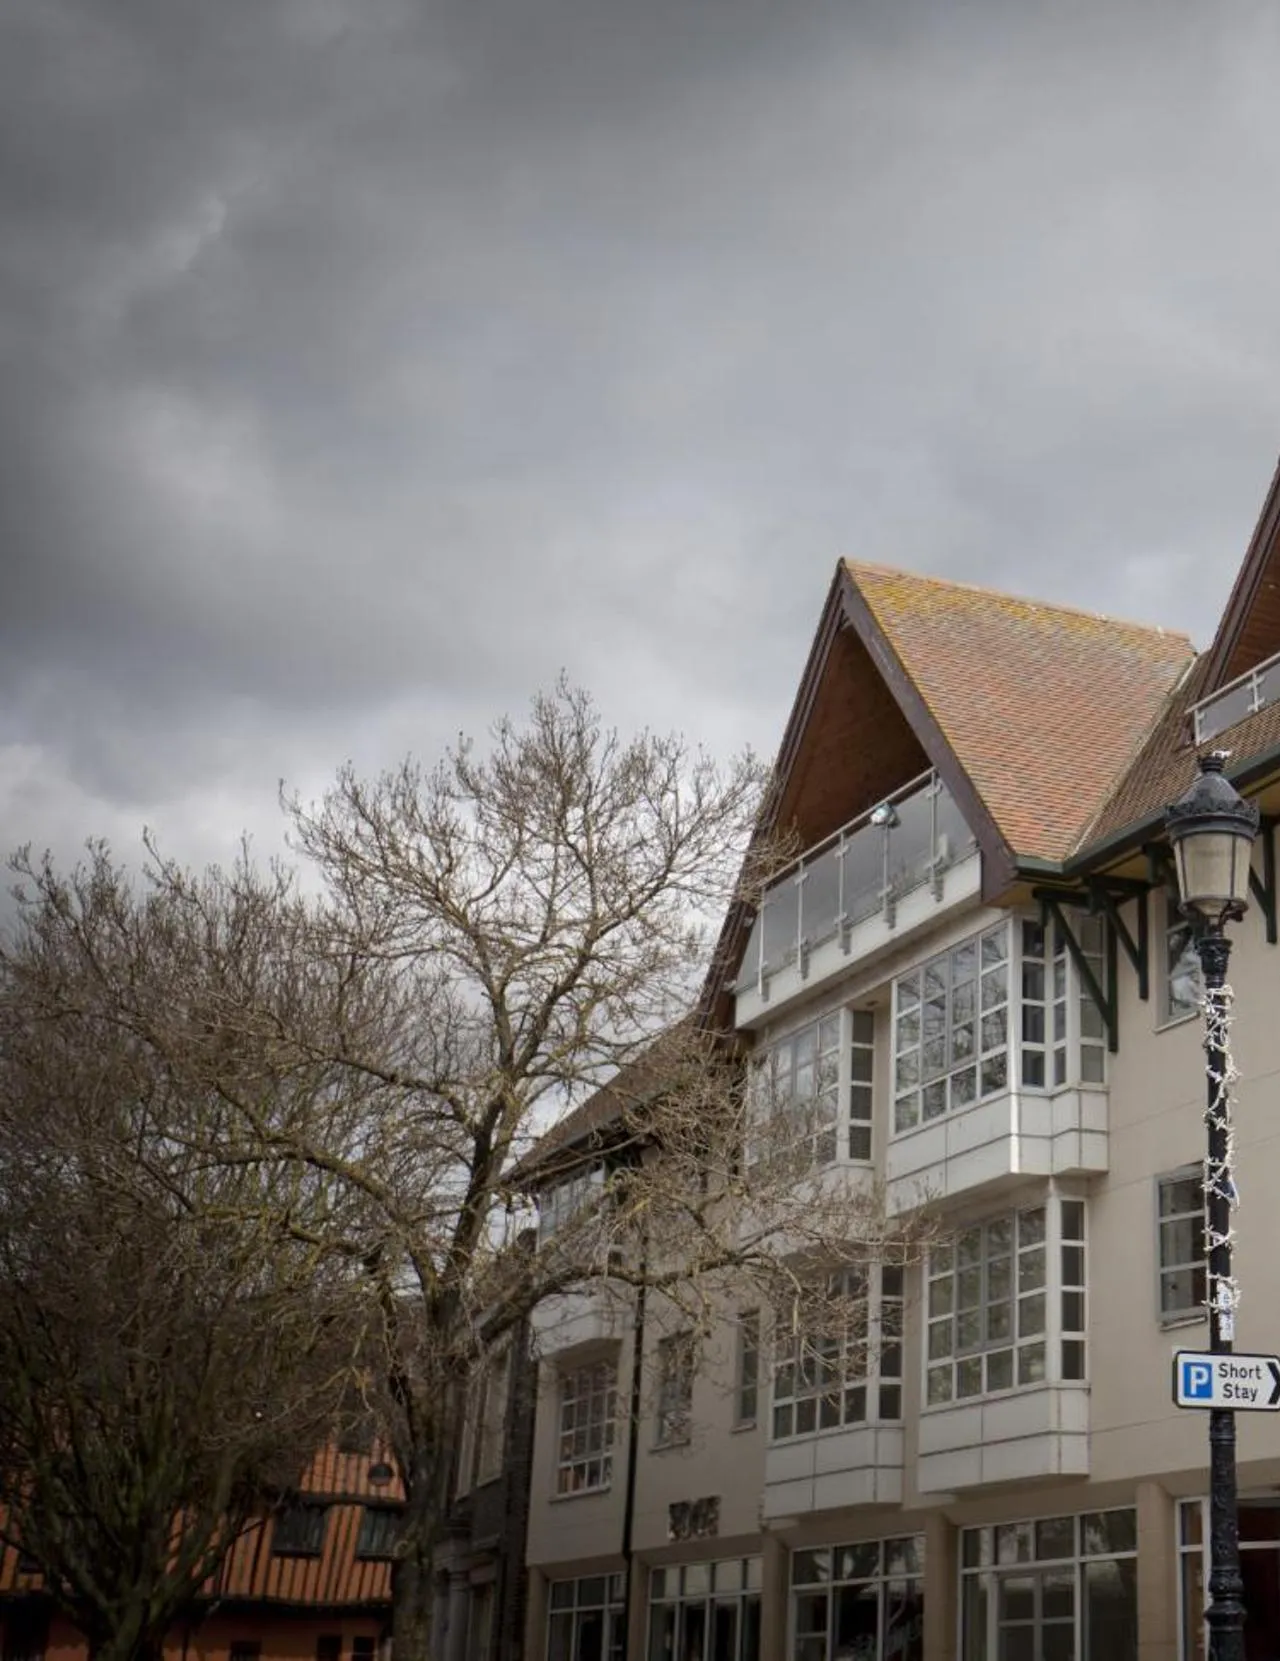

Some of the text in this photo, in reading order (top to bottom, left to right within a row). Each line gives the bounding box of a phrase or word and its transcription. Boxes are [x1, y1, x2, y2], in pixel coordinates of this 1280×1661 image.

[1218, 1363, 1261, 1379] Short
[1190, 1366, 1209, 1395] P
[1223, 1383, 1258, 1401] Stay
